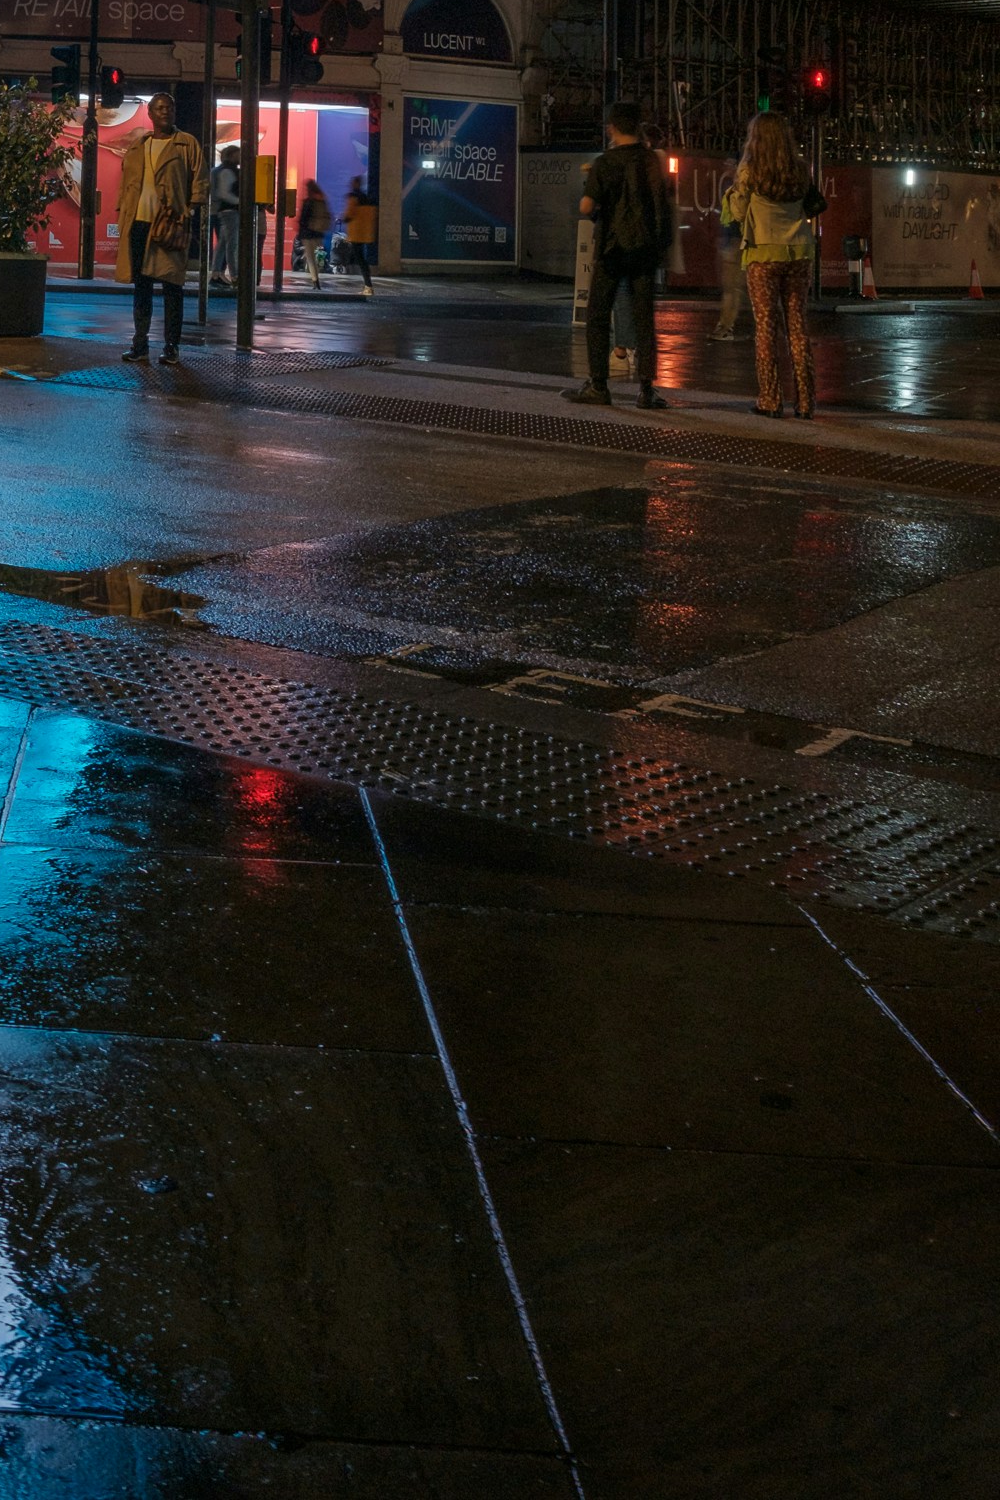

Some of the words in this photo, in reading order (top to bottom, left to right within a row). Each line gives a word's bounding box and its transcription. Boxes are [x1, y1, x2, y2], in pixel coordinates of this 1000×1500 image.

[108, 0, 185, 24] space
[424, 32, 474, 50] LUCENT
[410, 116, 457, 138] PRIME
[454, 144, 497, 163] space
